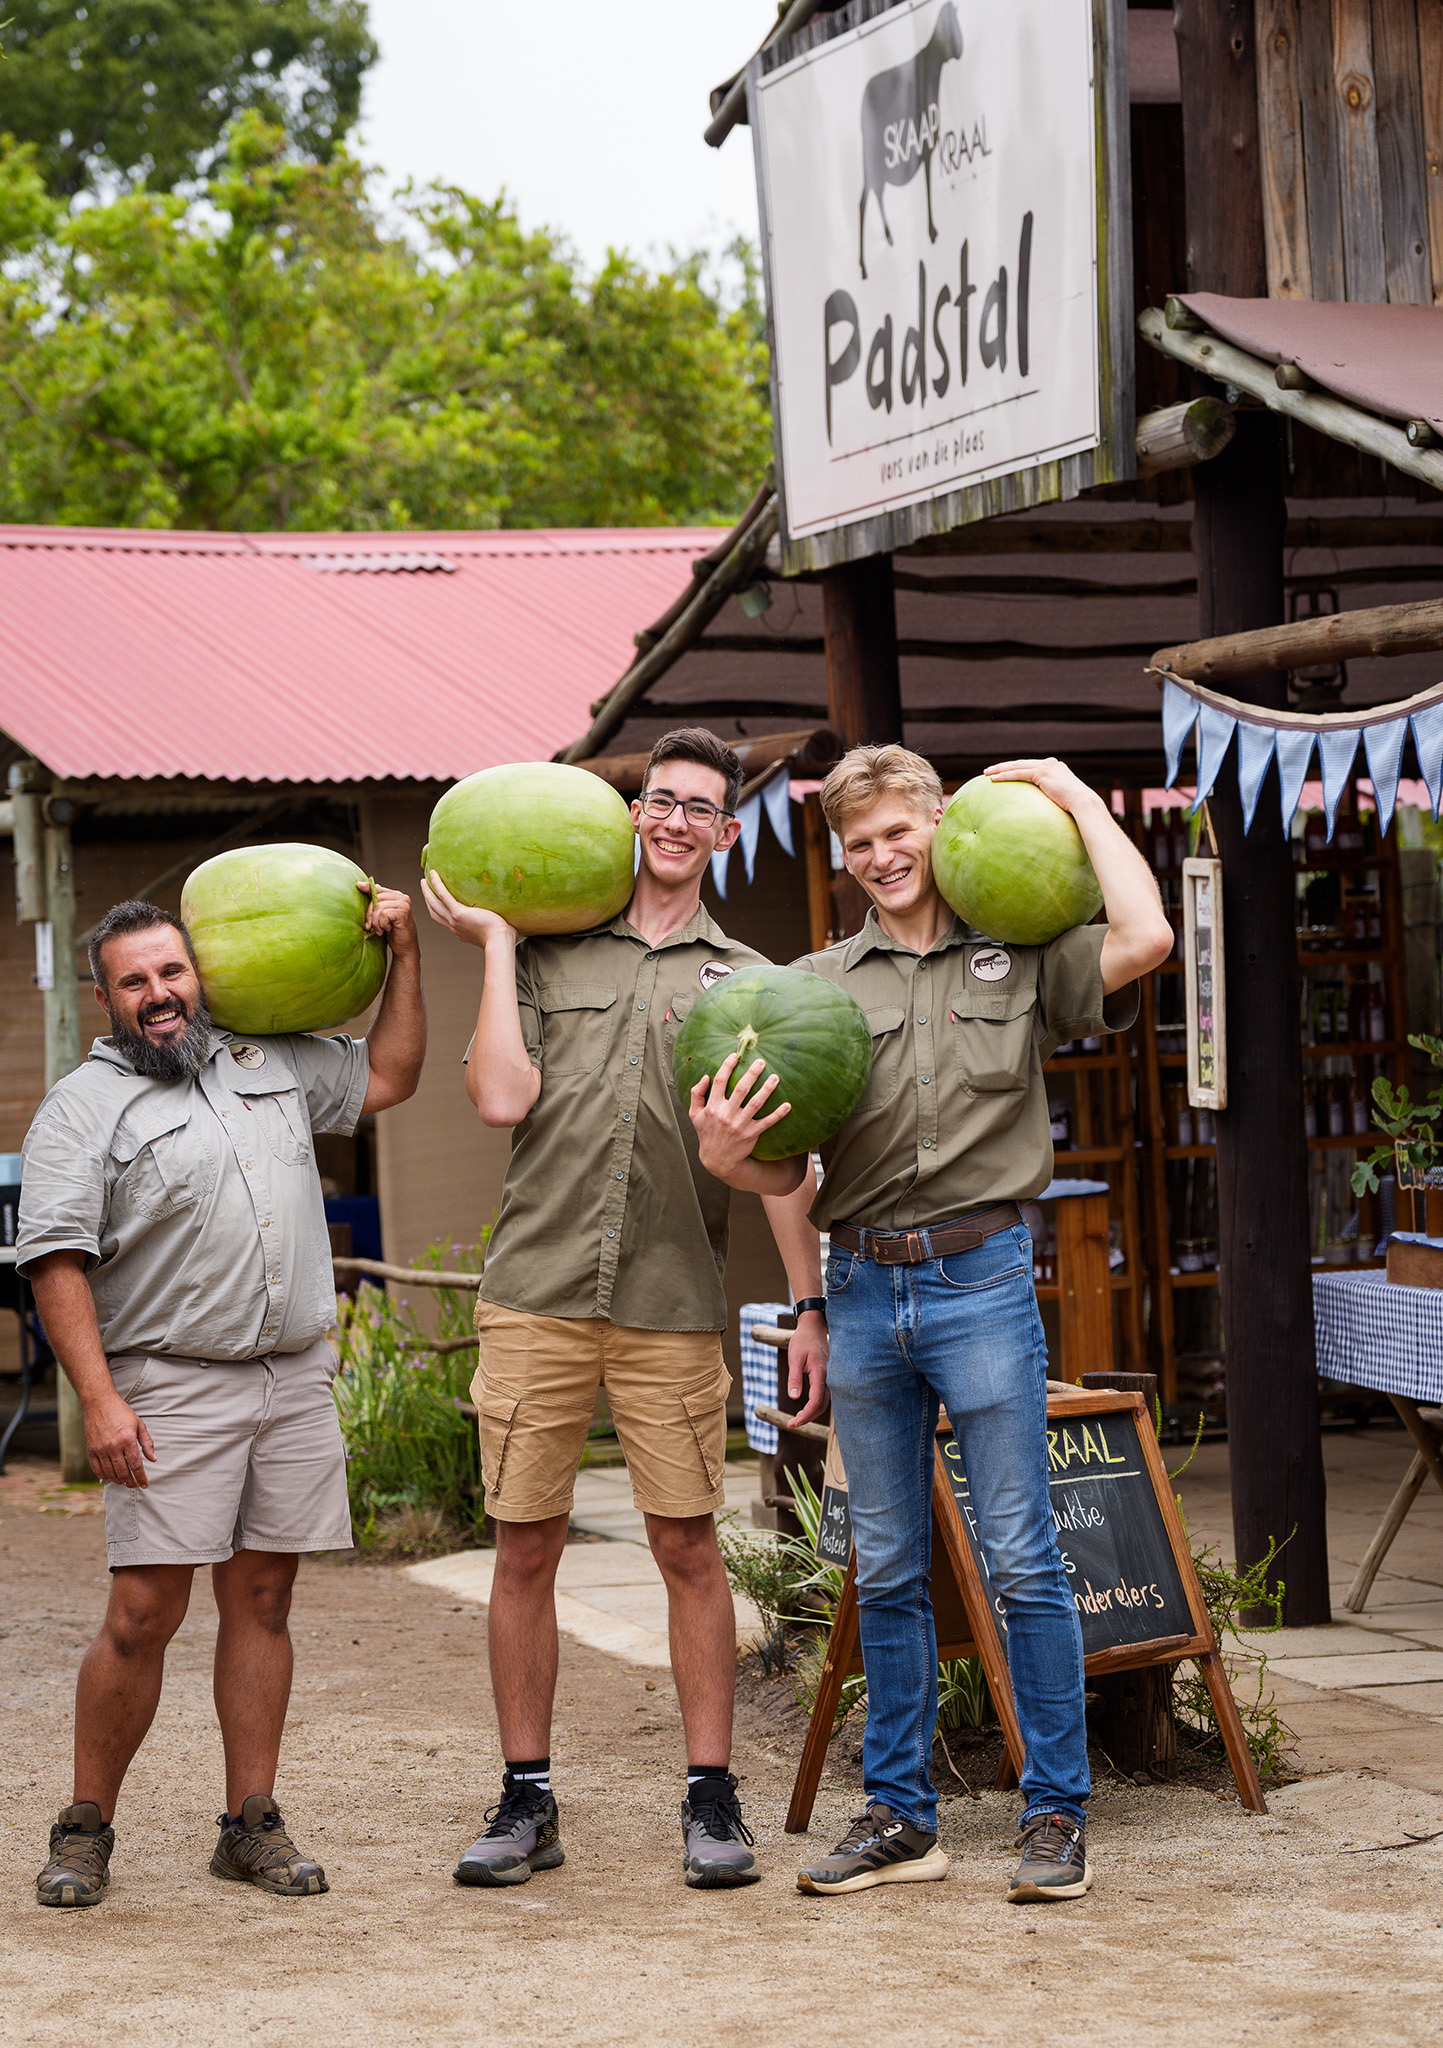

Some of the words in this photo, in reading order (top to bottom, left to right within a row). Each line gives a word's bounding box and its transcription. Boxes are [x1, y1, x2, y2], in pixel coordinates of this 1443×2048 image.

[883, 102, 939, 169] SKAAP
[940, 113, 992, 178] KRAAL
[824, 210, 1033, 448] Padstal
[880, 457, 903, 484] vers
[908, 449, 929, 473] van
[934, 438, 948, 466] die
[953, 429, 984, 467] plaas
